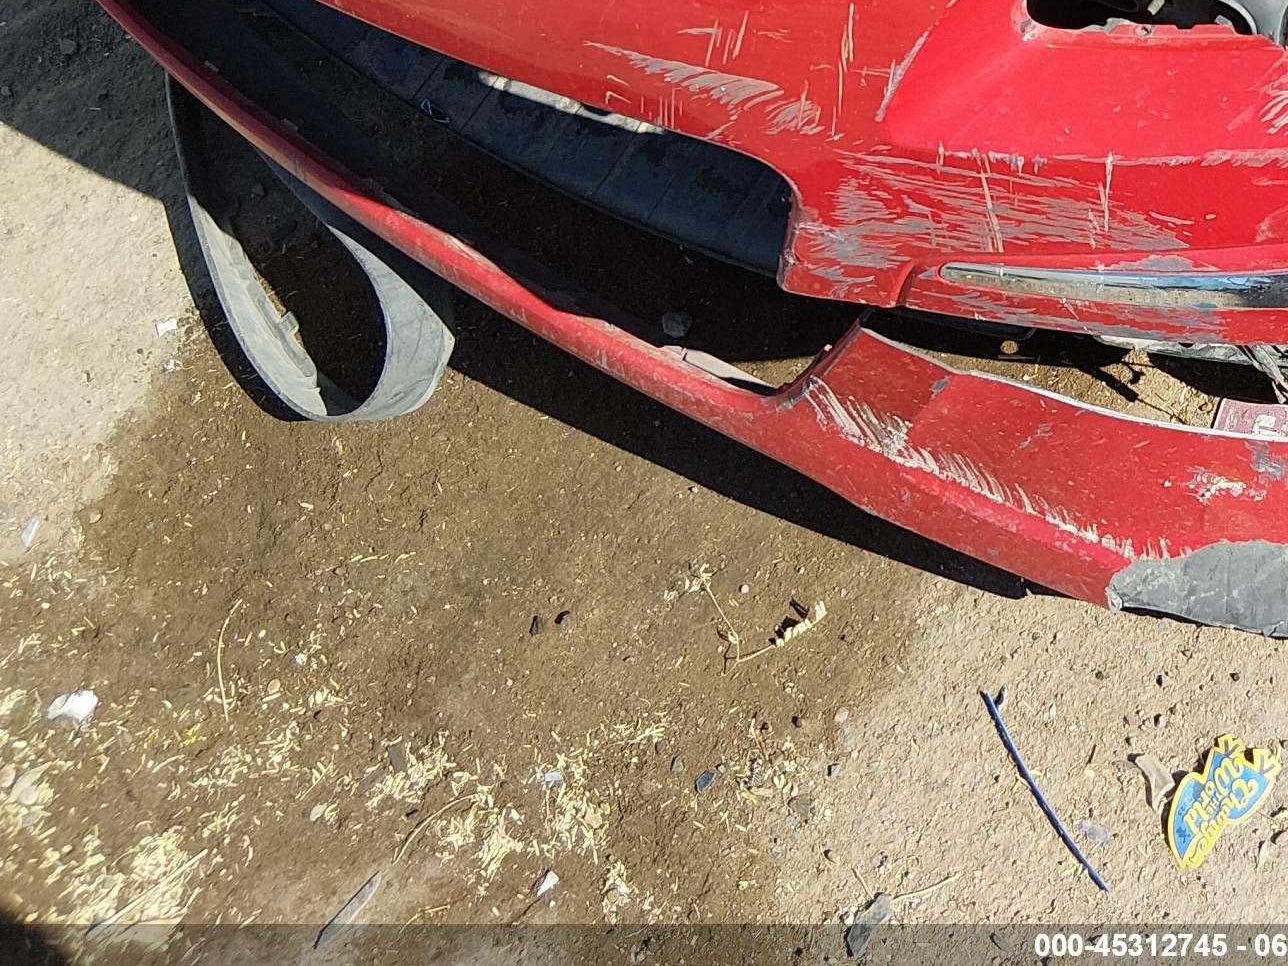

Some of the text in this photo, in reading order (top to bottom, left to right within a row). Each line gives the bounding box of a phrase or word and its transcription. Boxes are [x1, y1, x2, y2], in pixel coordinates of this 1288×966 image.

[1183, 756, 1246, 835] World
[1188, 778, 1259, 863] Change
[1206, 792, 1222, 816] THE
